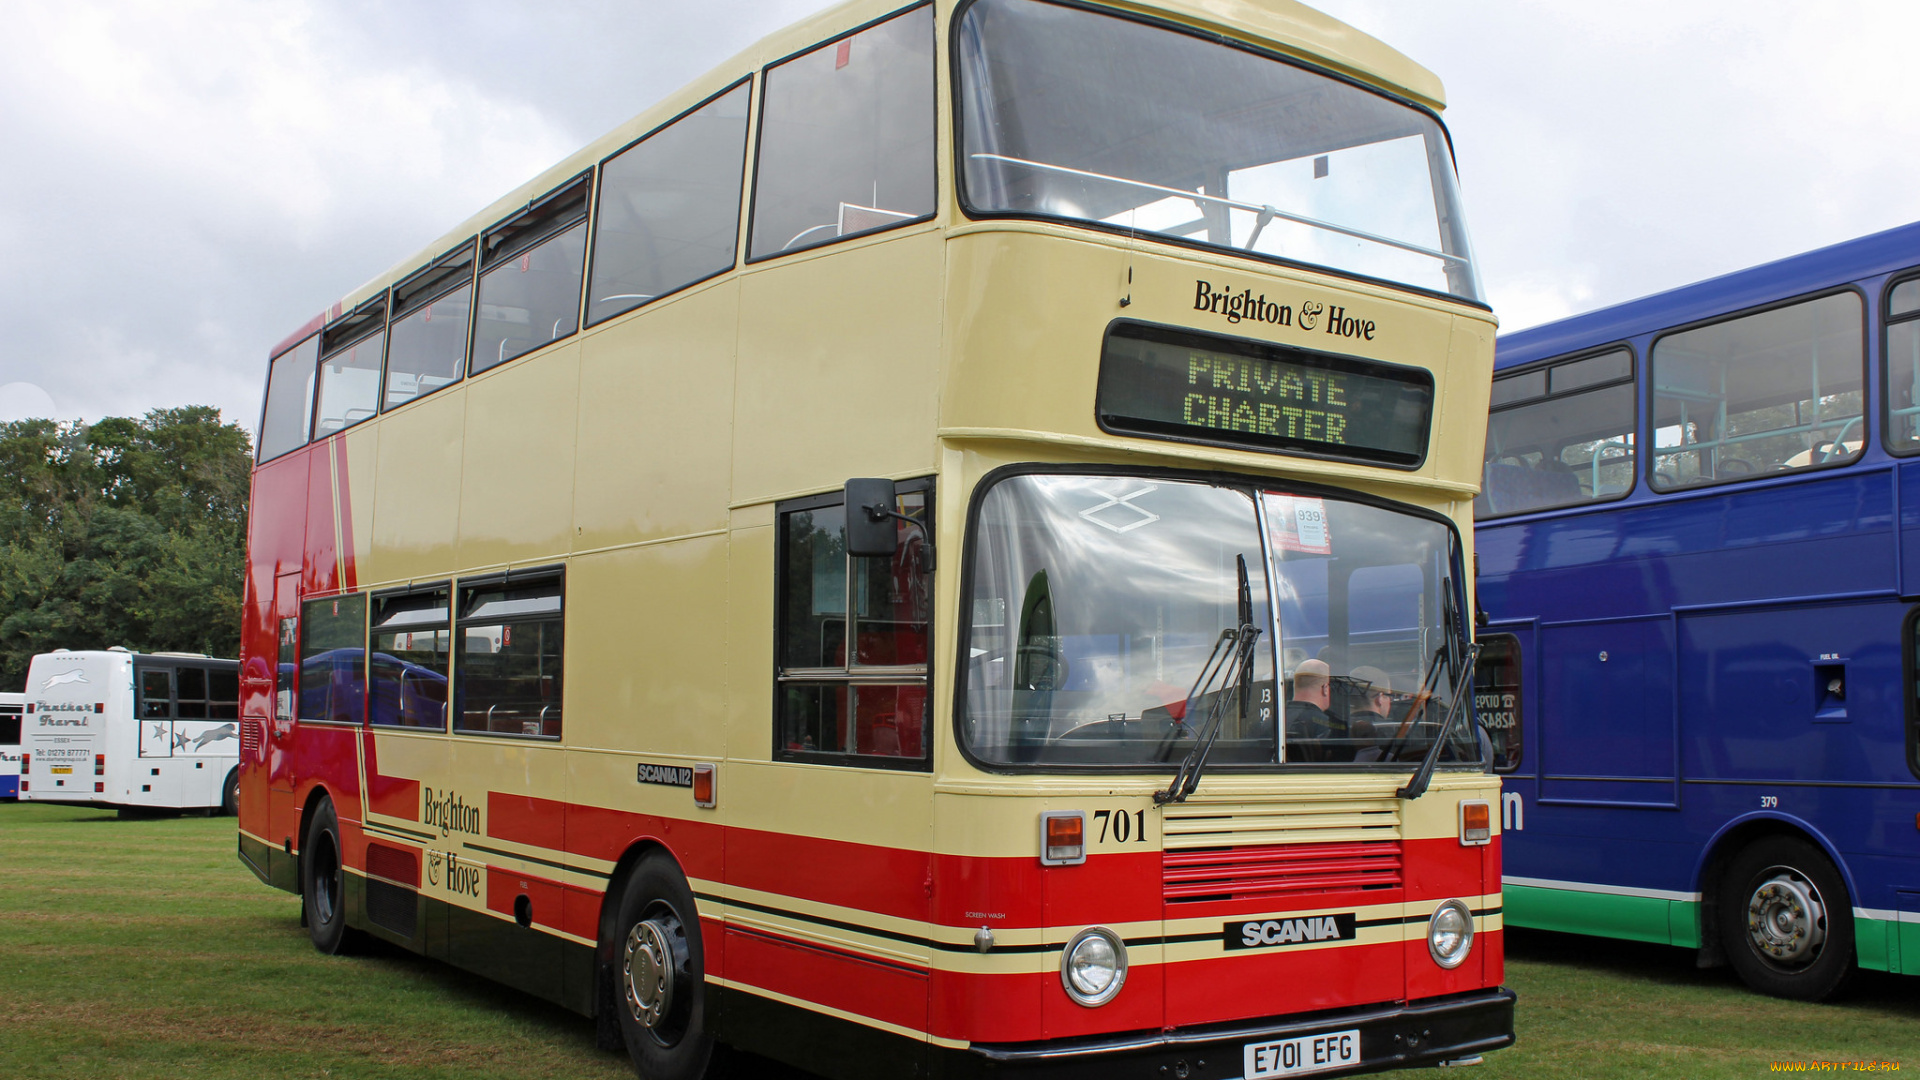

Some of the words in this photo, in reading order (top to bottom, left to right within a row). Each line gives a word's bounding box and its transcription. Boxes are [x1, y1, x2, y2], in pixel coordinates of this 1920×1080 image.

[1193, 280, 1292, 326] Brighton
[1299, 300, 1323, 331] &
[1326, 305, 1376, 341] Hove
[1188, 351, 1347, 406] PRIVATE
[1184, 393, 1347, 444] CHARTER
[1298, 509, 1320, 522] 939
[36, 700, 93, 712] Panther
[39, 714, 88, 727] Travel
[639, 764, 678, 784] SCANIA
[423, 787, 481, 837] Brighton
[1760, 796, 1778, 808] 379
[1093, 808, 1148, 844] 701
[446, 851, 480, 898] Hove
[965, 911, 987, 919] SCREEN
[988, 912, 1006, 920] WASH
[1241, 916, 1341, 947] SCANIA
[1254, 1042, 1302, 1074] E701
[1313, 1035, 1352, 1065] EFG
